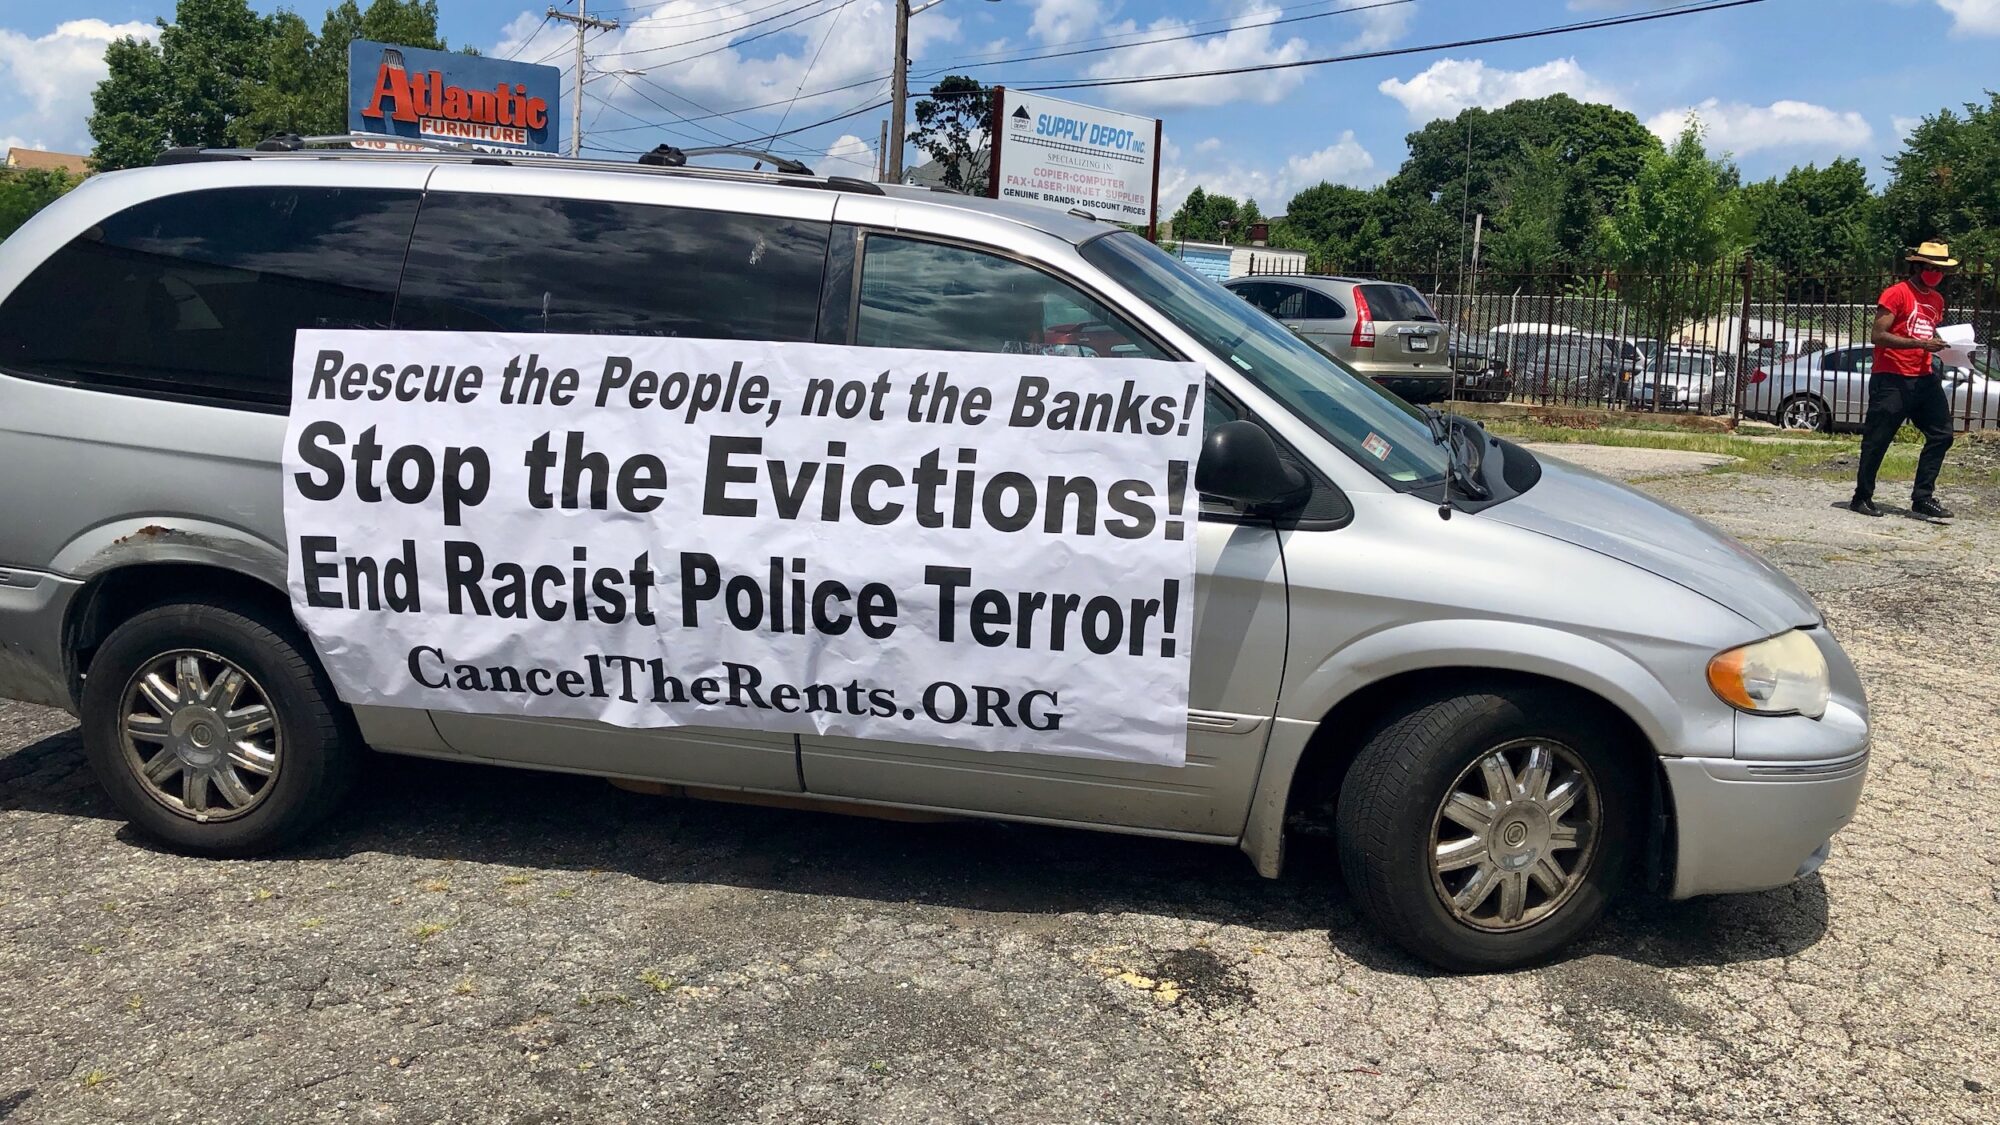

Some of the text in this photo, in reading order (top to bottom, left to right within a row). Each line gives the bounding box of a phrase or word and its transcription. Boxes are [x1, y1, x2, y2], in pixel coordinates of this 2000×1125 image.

[361, 50, 548, 130] Atlantic
[421, 118, 525, 144] FURNITURE
[1037, 113, 1088, 142] SUPPLY
[1089, 123, 1134, 150] DEPOT
[1047, 153, 1112, 171] SPECIALIZING IN
[1003, 187, 1146, 216] GENUINE BRANDS DISCOUNT PRICES
[1105, 189, 1145, 204] SUPPLIES
[308, 349, 1200, 437] Rescue the People, not the Banks!
[294, 420, 1189, 542] Stop the Evictions!
[299, 535, 1180, 659] End Racist Police Terror!
[407, 645, 1064, 732] CancelTheRents.ORG
